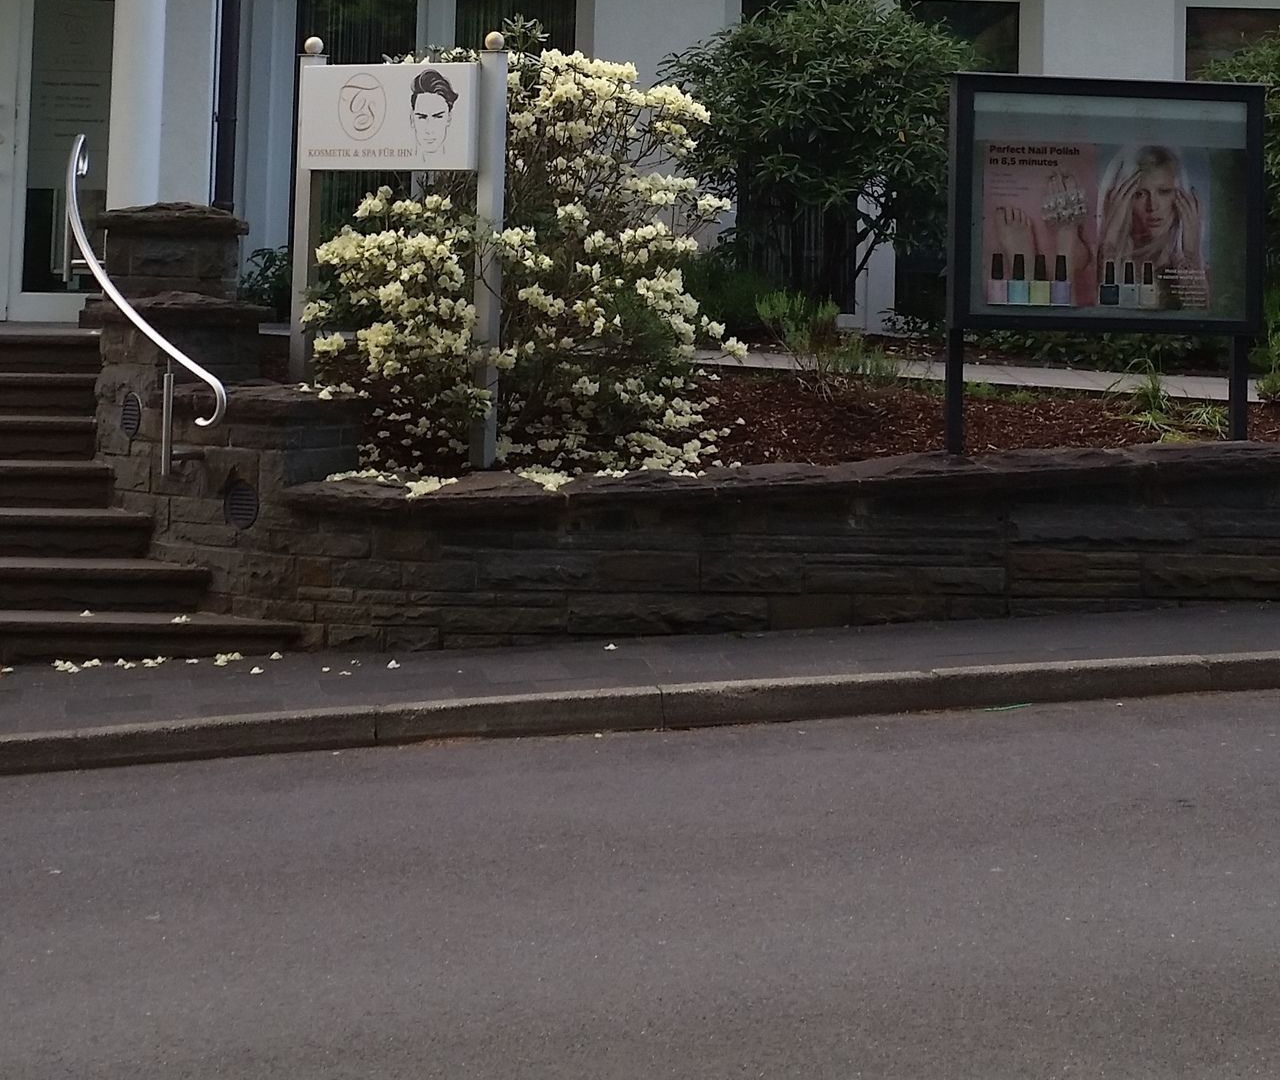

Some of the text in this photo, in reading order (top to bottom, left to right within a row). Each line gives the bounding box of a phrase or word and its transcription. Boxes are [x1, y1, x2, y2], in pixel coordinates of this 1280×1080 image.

[308, 147, 413, 158] KOSMETIK & SPA FÜR IHN
[989, 145, 1080, 156] Perfect Nail Polish
[989, 157, 999, 165] in
[1019, 158, 1059, 167] minutes
